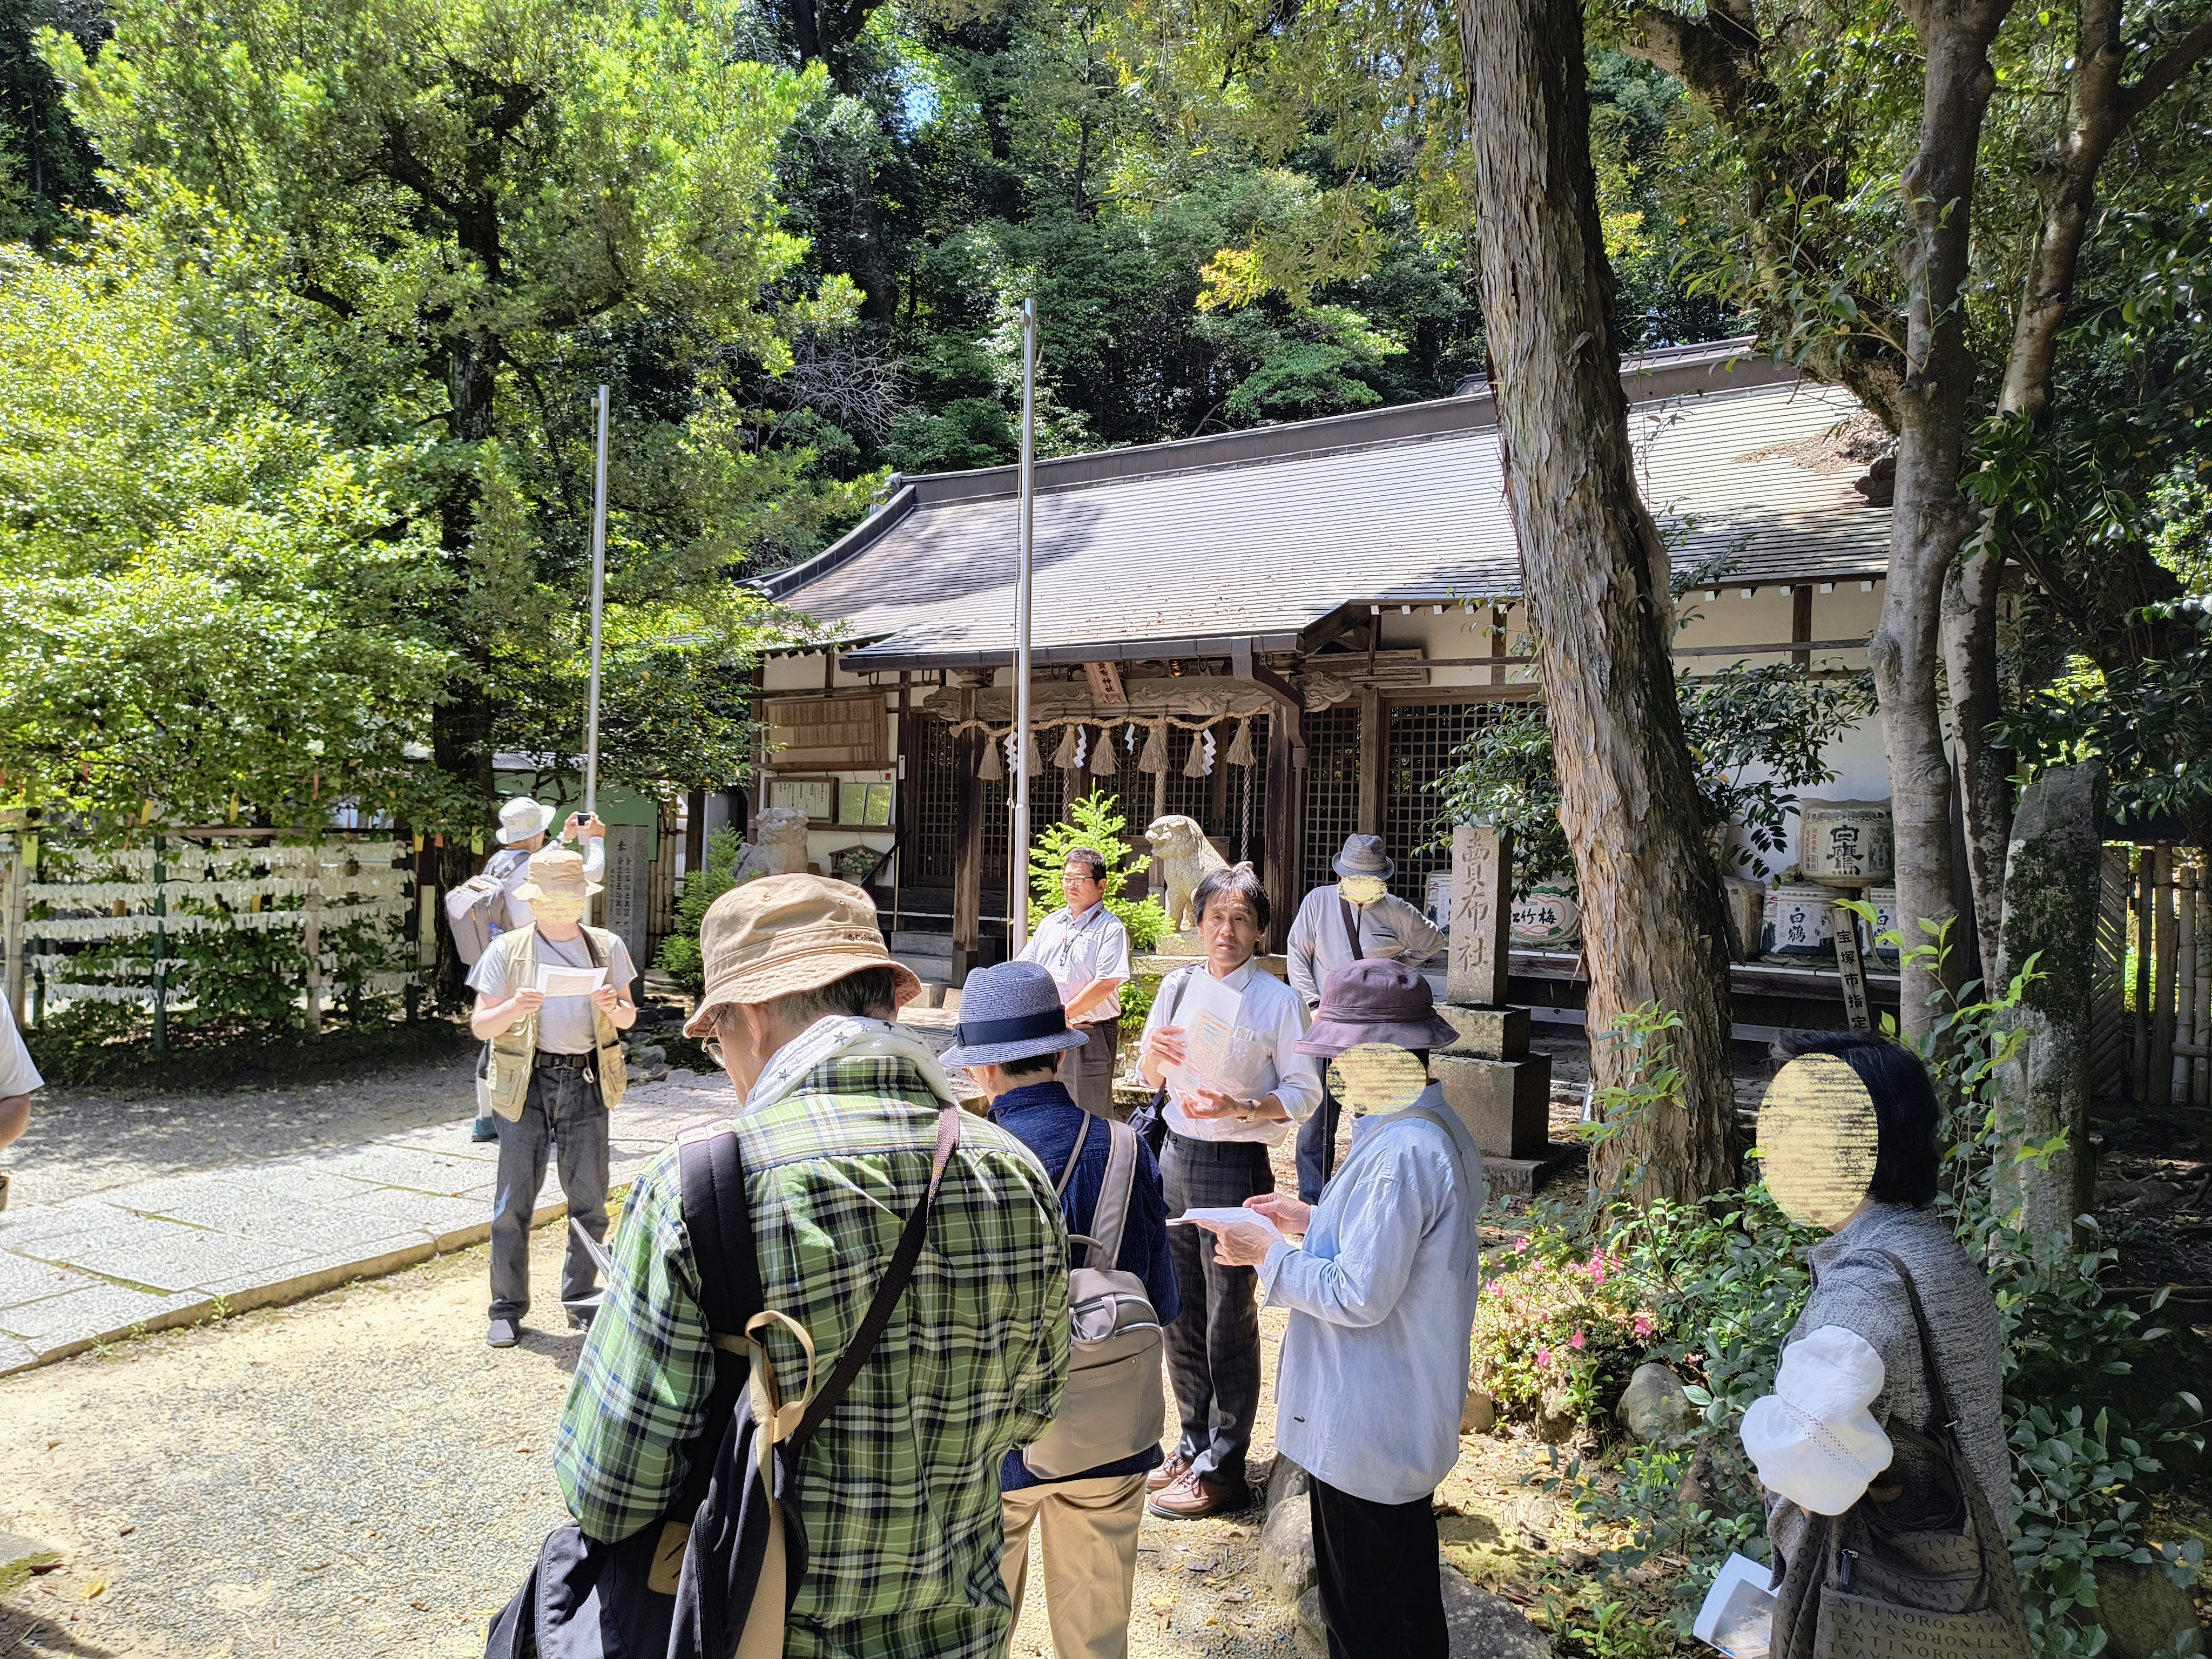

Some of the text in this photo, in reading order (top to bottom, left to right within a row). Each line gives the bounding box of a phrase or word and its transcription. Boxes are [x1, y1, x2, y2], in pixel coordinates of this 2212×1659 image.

[1788, 907, 1806, 943] 白鶴
[1836, 929, 1868, 1029] 宝塚市指定
